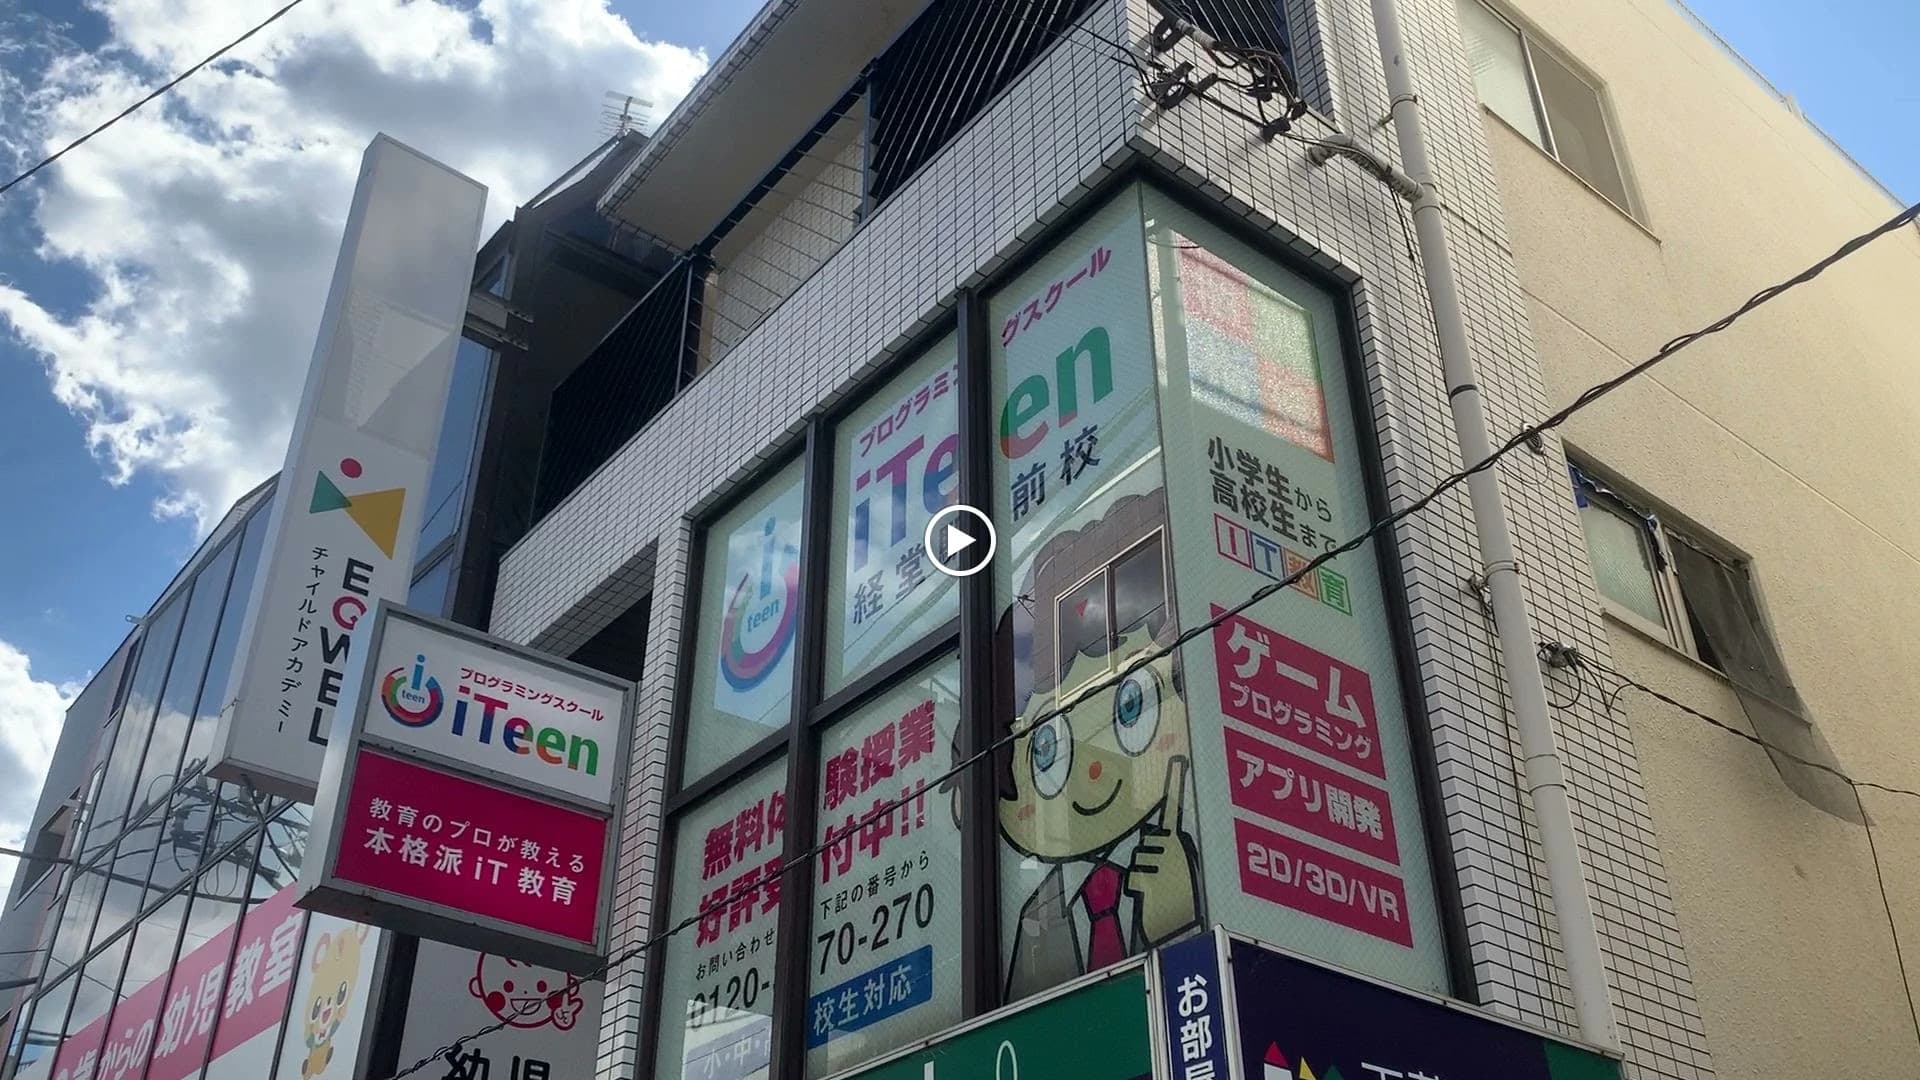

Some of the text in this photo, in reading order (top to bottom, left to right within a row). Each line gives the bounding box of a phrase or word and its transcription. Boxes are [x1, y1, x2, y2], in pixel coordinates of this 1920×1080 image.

[1208, 436, 1332, 522] 小学生から
[1209, 469, 1337, 560] 高校生まで
[278, 546, 328, 733] チャイルドアカデミー
[746, 599, 780, 634] teen
[401, 690, 426, 705] teen
[460, 666, 604, 722] プログラミングスクール
[1226, 622, 1366, 729] ゲーム
[451, 685, 600, 777] iTeen
[1229, 681, 1372, 760] プログラミング
[369, 797, 584, 873] 教育のプロが教える
[1236, 749, 1384, 841] アプリ開発
[1247, 842, 1401, 923] 2D/3D/VR
